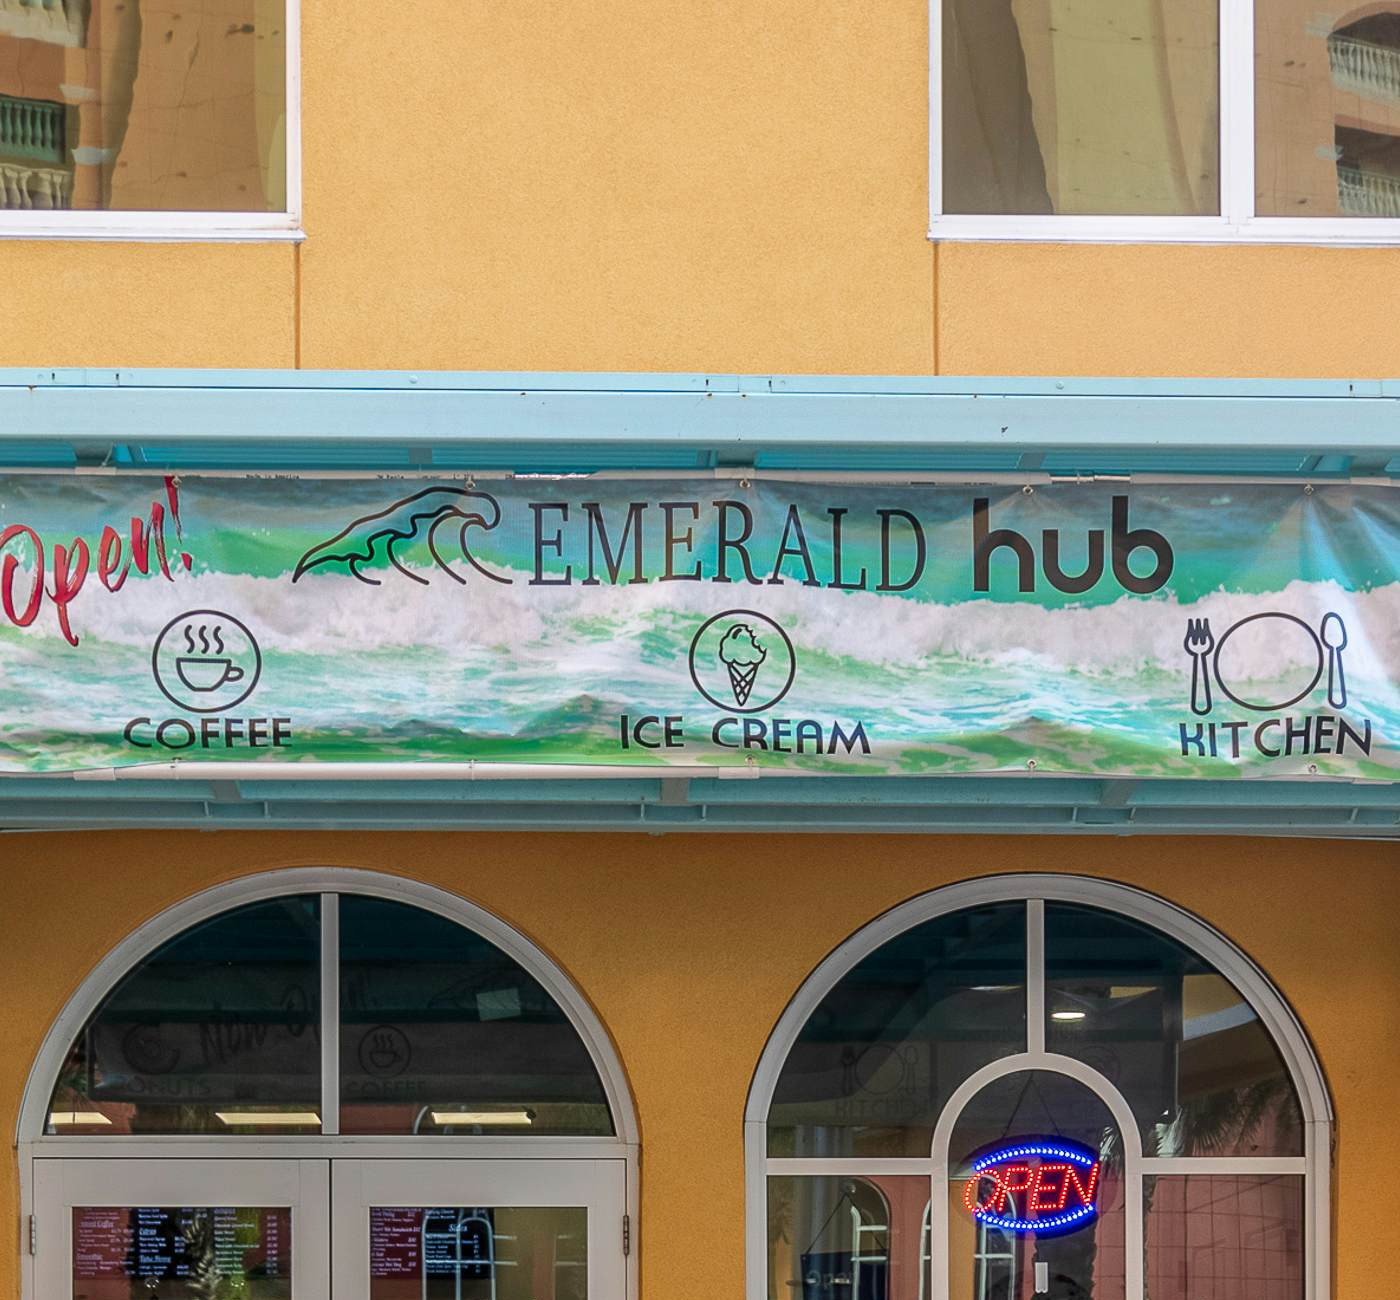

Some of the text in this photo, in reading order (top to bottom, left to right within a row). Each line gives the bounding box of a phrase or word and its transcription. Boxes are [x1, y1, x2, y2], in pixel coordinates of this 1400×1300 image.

[0, 476, 193, 647] Open!
[529, 496, 1175, 595] EMERALD hub
[123, 716, 293, 749] COFFEE
[620, 714, 872, 757] ICE CREAM
[1179, 715, 1372, 759] KITCHEN
[963, 1161, 1100, 1216] OPEN
